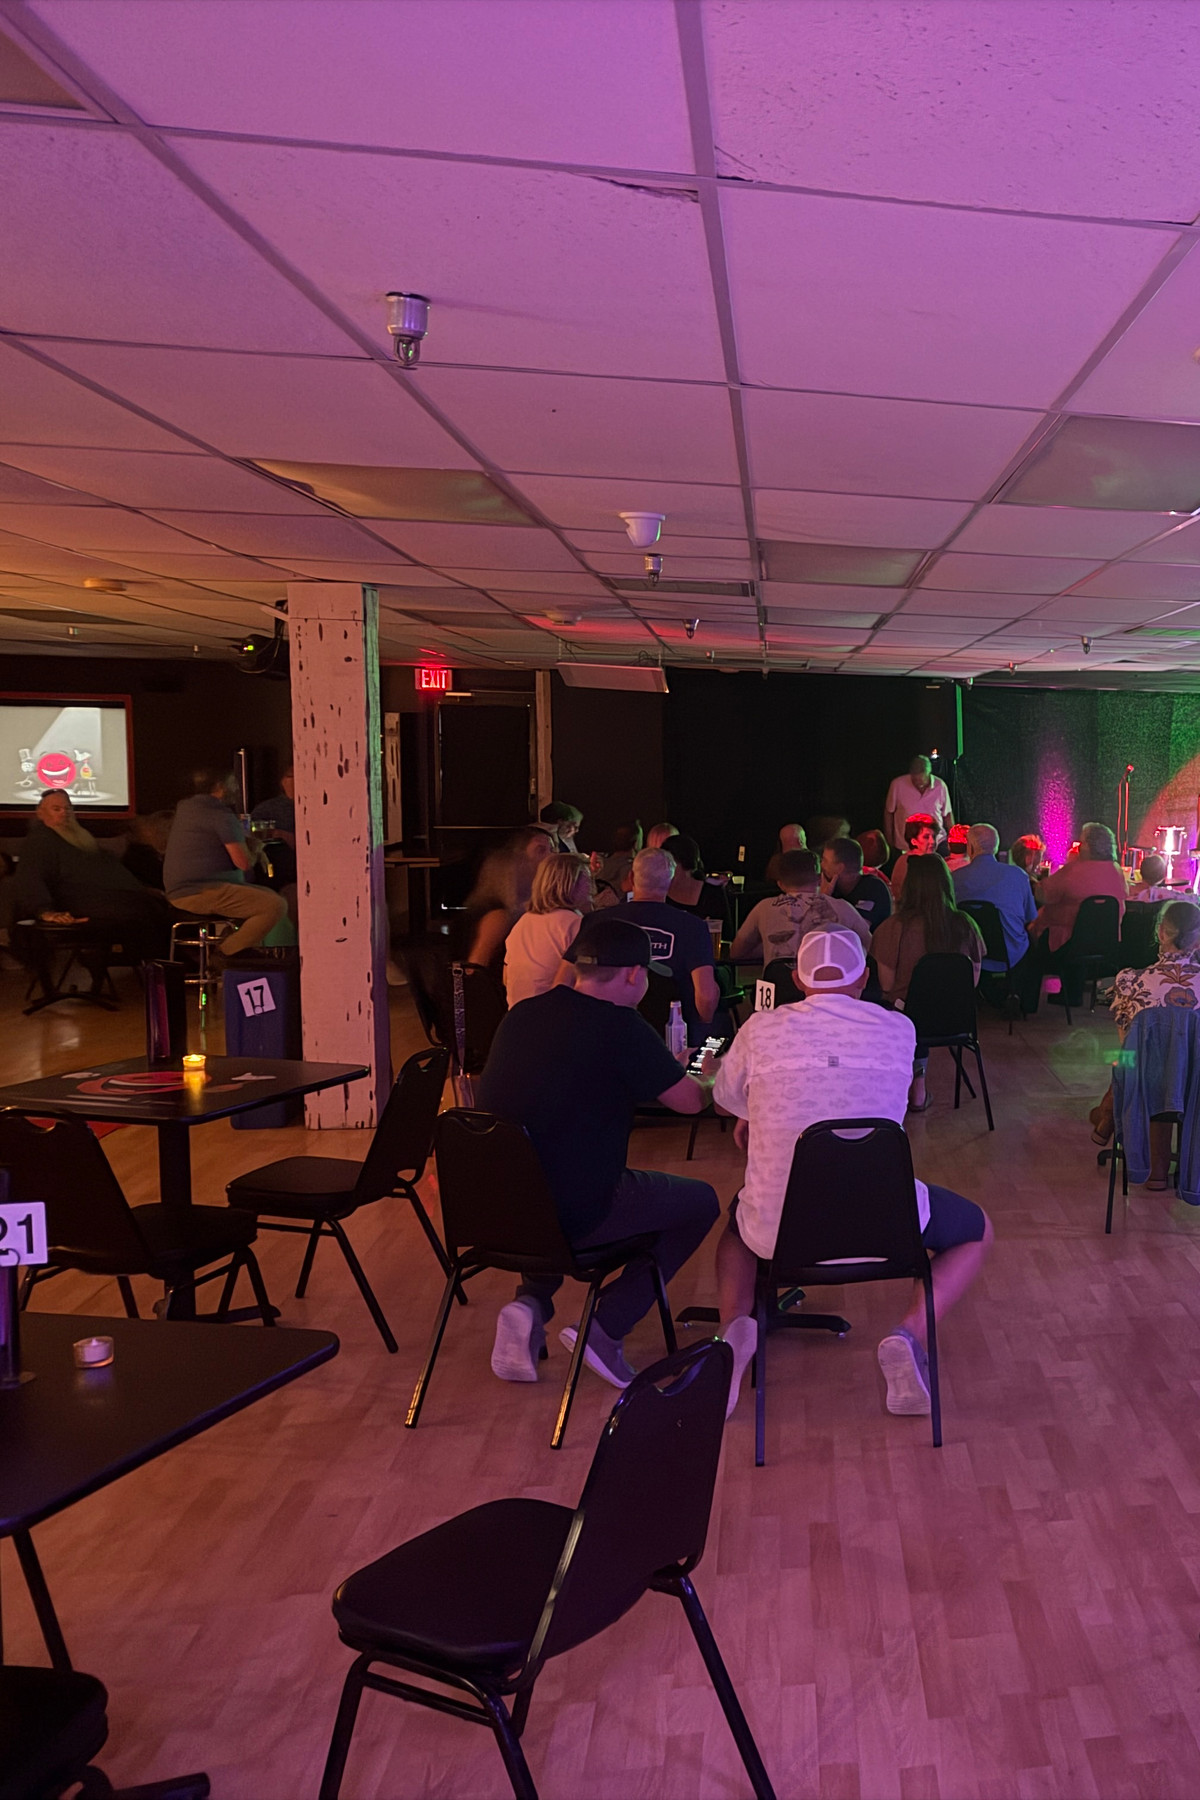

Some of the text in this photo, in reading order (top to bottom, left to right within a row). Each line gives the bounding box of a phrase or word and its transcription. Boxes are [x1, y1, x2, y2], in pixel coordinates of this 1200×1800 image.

[421, 669, 447, 688] EXIT
[245, 985, 264, 1009] 17
[759, 986, 771, 1009] 18
